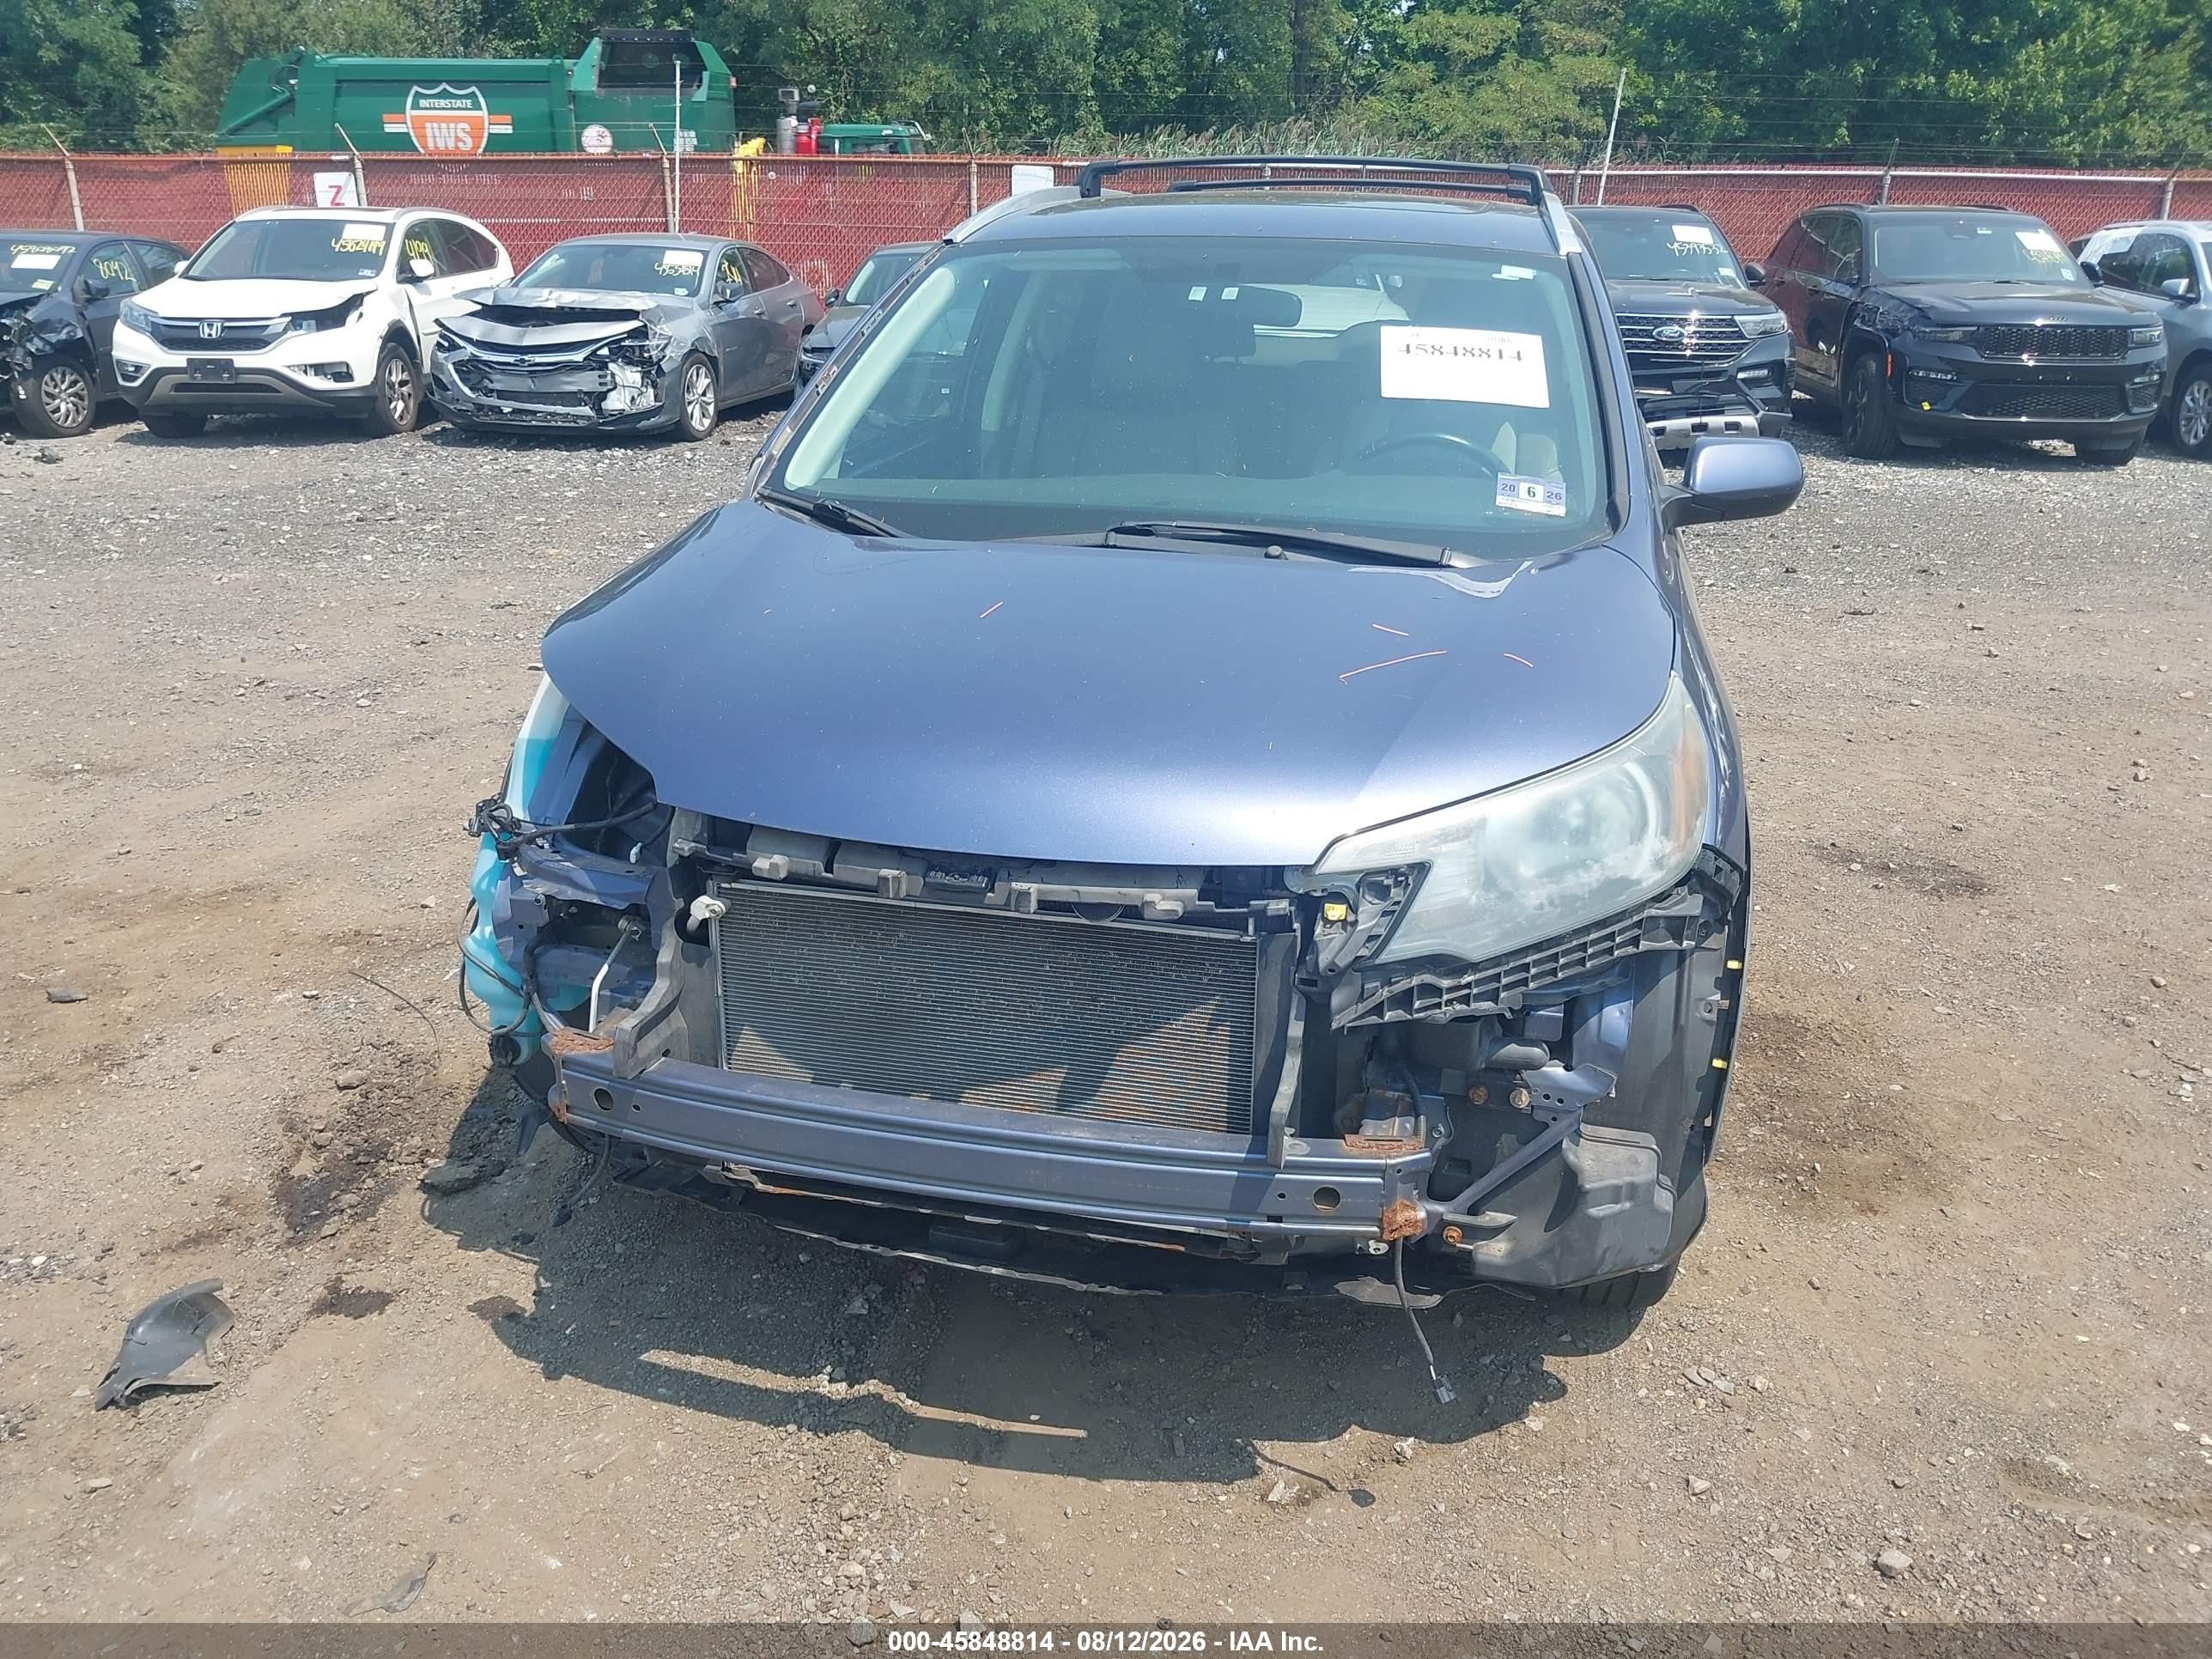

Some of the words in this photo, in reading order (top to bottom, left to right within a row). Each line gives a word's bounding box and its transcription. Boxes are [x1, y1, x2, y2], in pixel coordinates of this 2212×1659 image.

[418, 99, 473, 109] INTERSTATE
[425, 122, 471, 150] IWS
[1396, 343, 1523, 362] 45848814
[1501, 483, 1516, 493] 20
[1527, 486, 1536, 498] 6
[1547, 490, 1562, 501] 26
